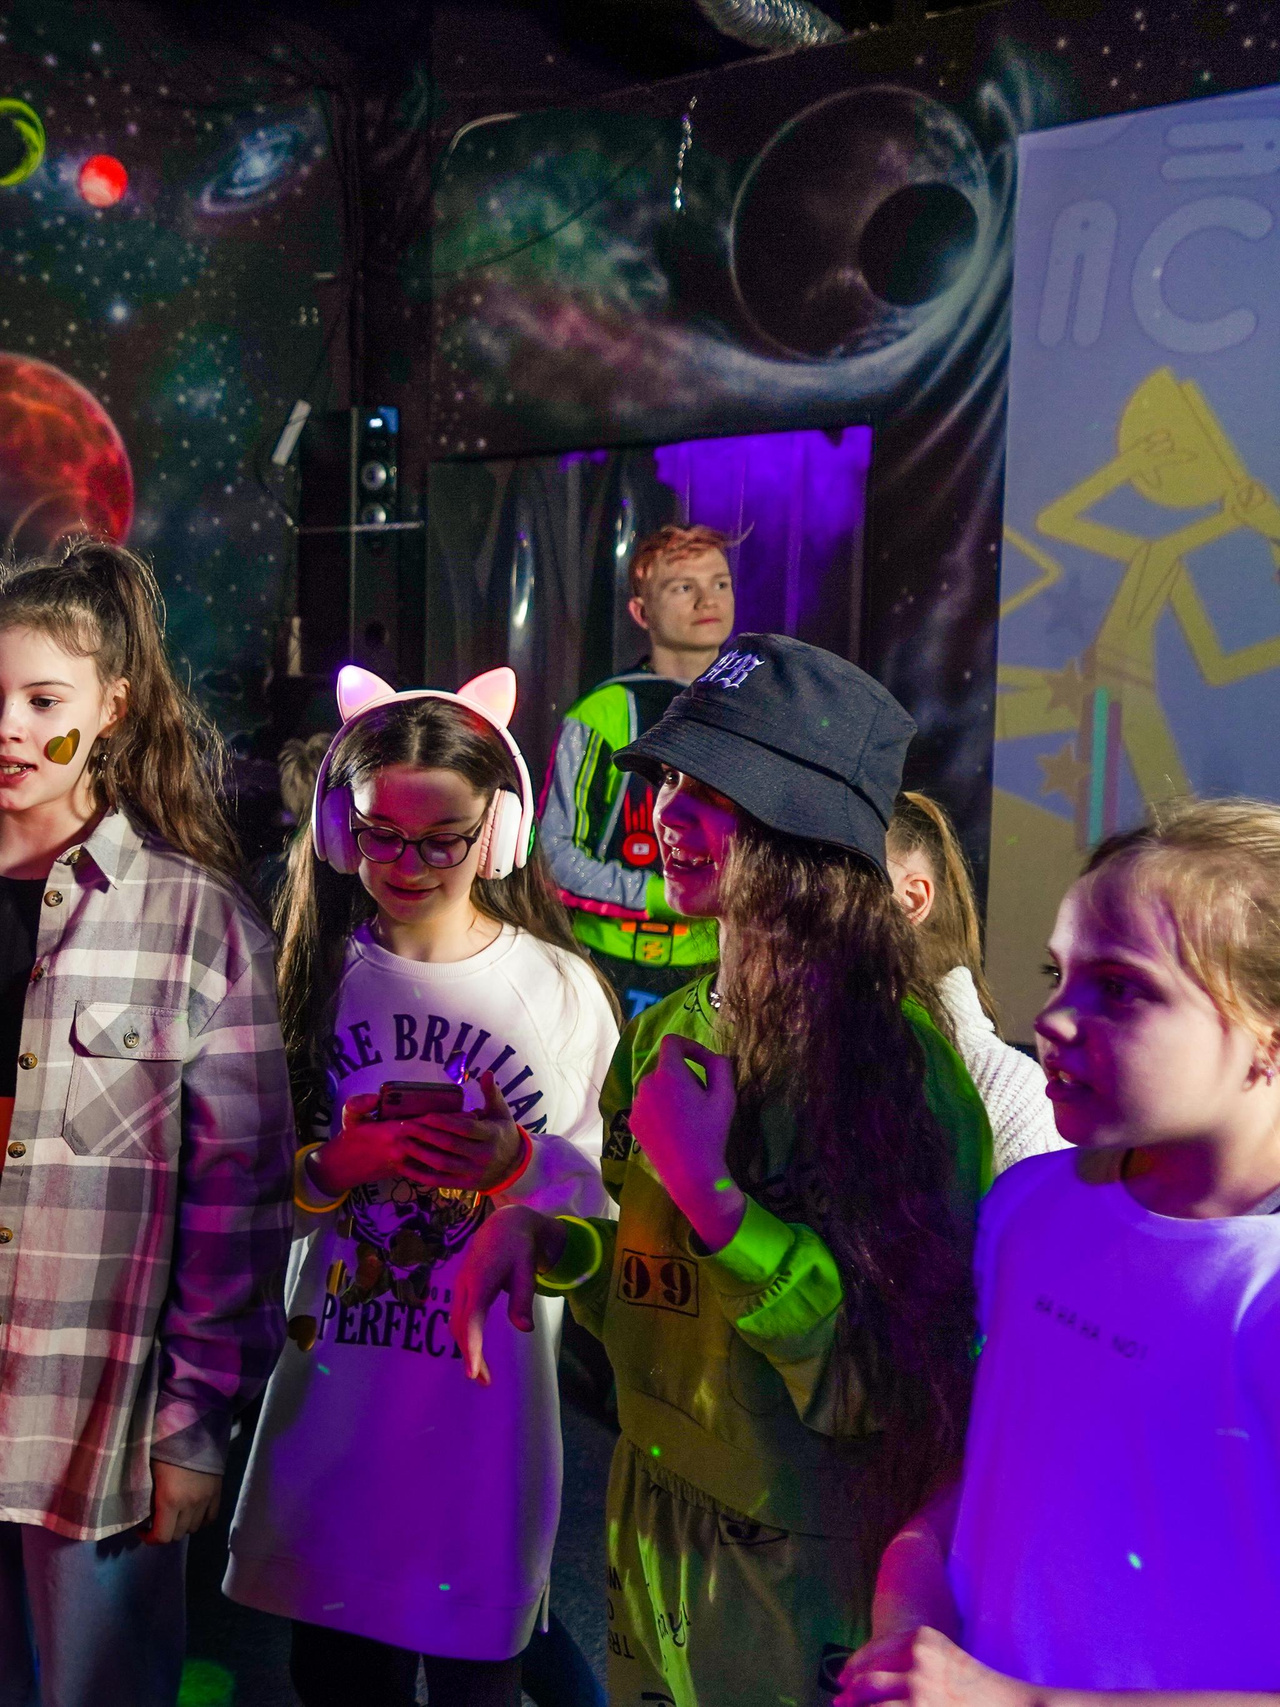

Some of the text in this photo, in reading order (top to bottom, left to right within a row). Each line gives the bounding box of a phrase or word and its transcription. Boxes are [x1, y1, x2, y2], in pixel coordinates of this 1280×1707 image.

[324, 1020, 384, 1080] RE
[622, 1255, 693, 1306] 99
[317, 1291, 463, 1359] PERFEC
